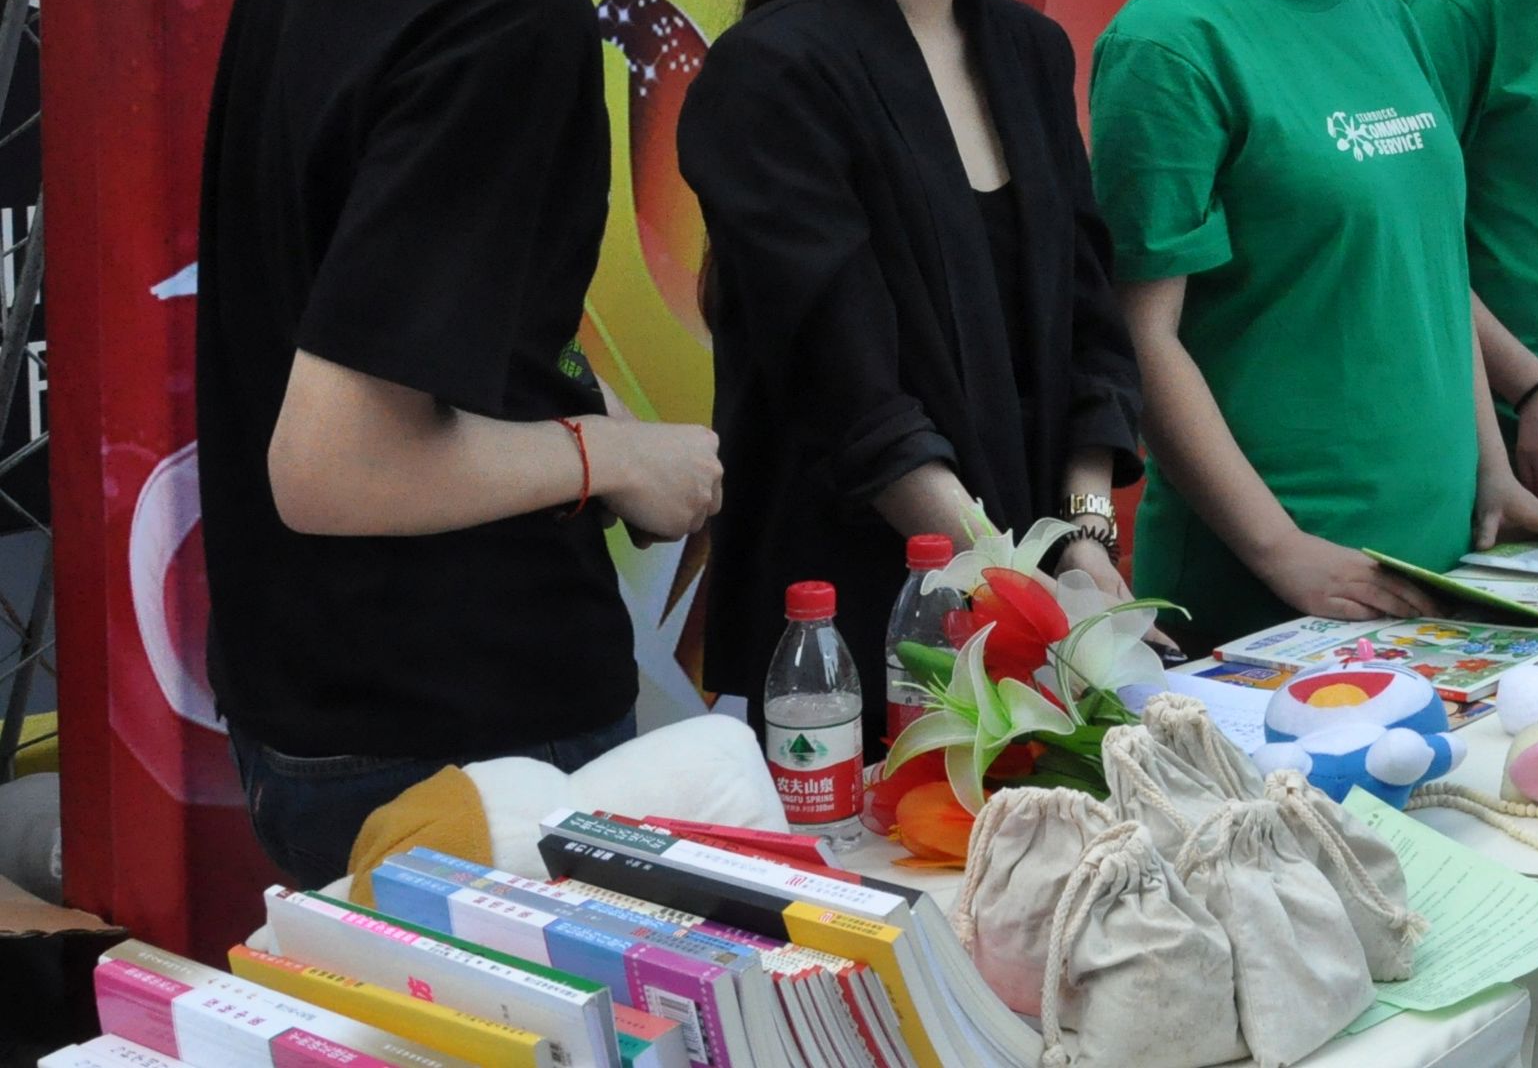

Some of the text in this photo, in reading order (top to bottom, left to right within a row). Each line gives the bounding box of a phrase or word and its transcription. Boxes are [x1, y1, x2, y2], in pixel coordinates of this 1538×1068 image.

[1373, 131, 1424, 155] SERVICE
[777, 776, 835, 794] 农夫山泉
